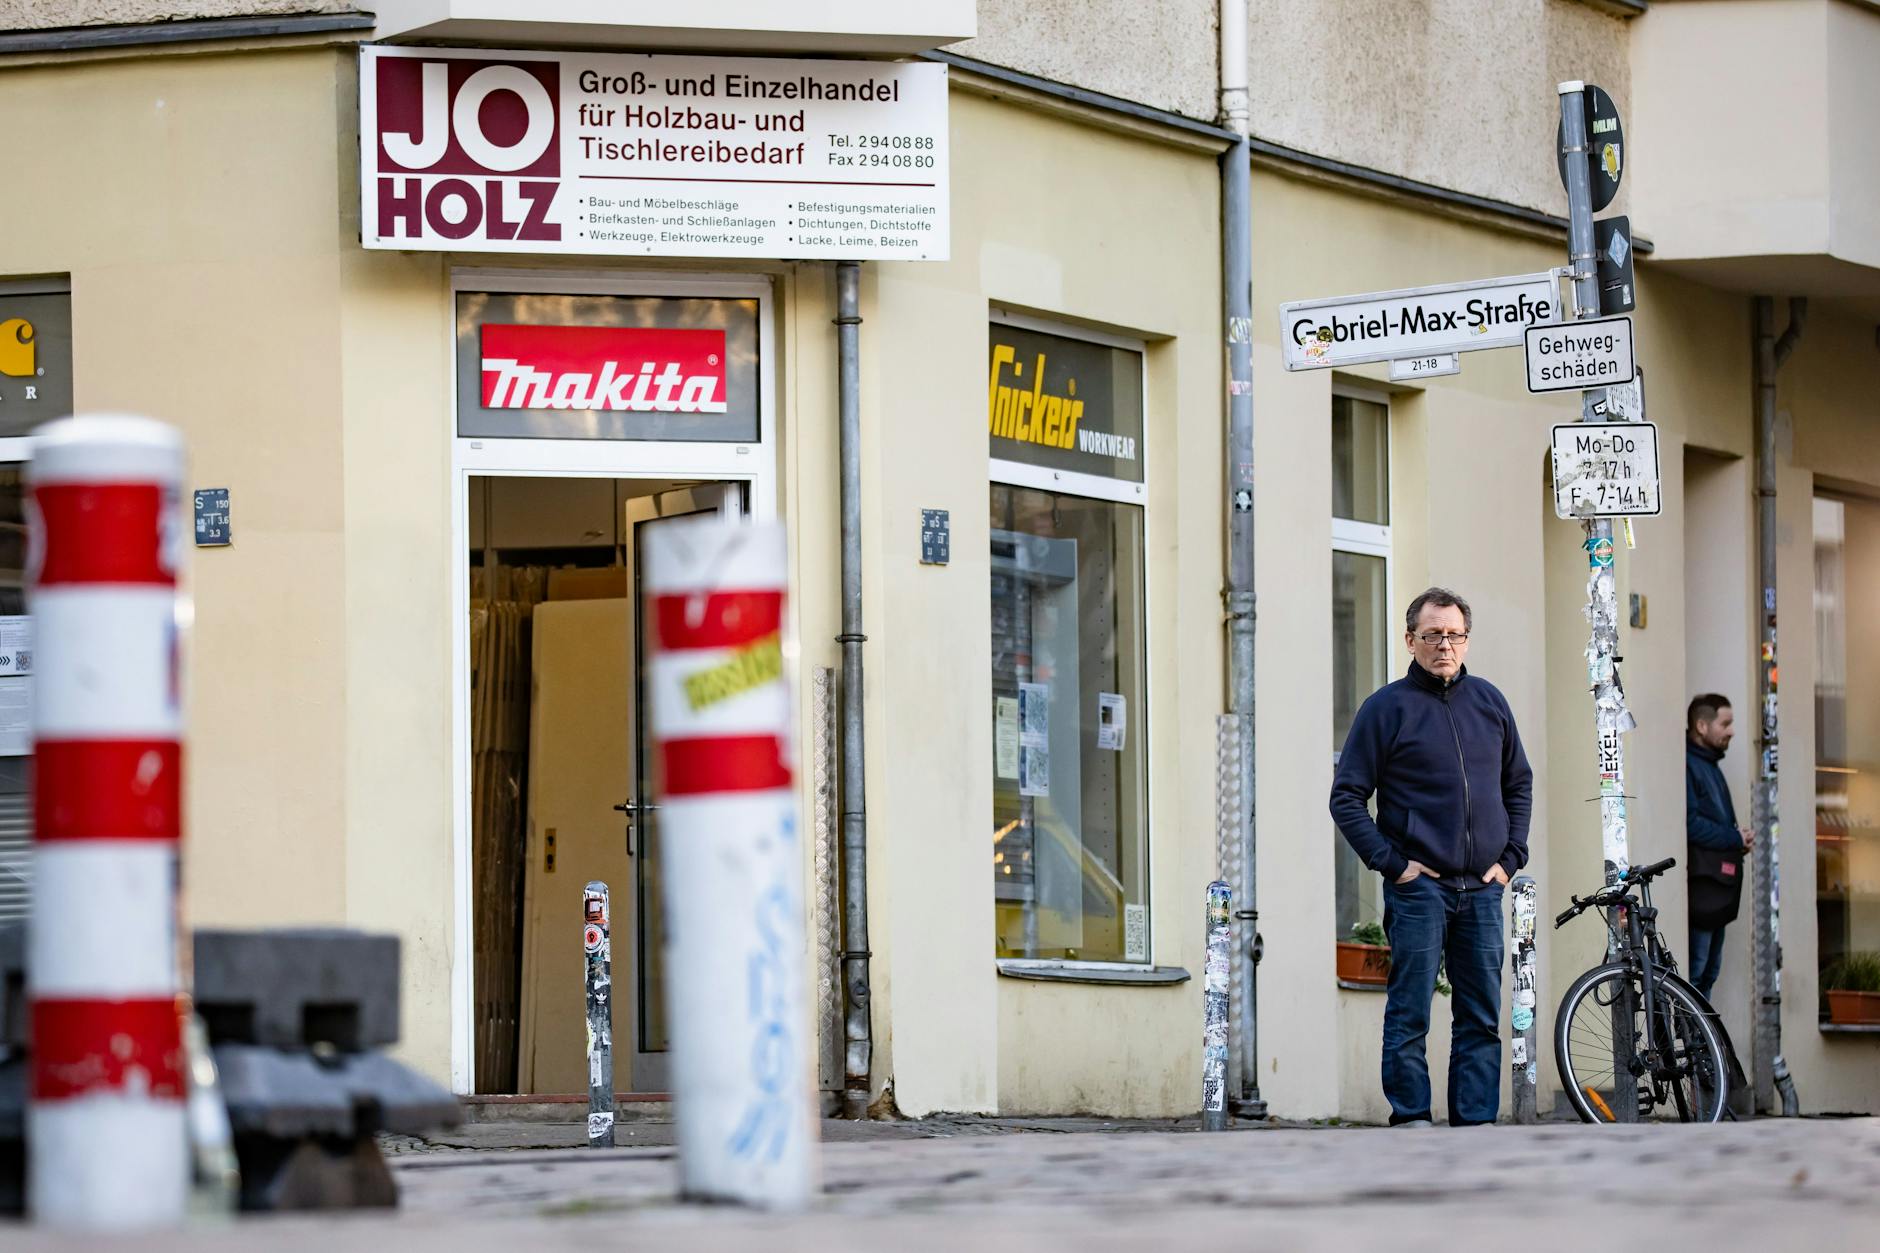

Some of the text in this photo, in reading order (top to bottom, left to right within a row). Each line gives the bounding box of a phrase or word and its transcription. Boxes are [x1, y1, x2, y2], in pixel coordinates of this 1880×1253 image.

[579, 70, 899, 102] Groß- und Einzelhandel
[382, 62, 555, 172] JO
[579, 103, 805, 132] für Holzbau- und
[579, 136, 805, 165] Tischlereibedarf
[828, 134, 854, 148] Tel.
[828, 152, 854, 166] Fax
[377, 177, 562, 242] HOLZ
[588, 196, 740, 212] Bau- und Möbelbeschläge
[797, 201, 936, 216] Befestigungsmaterialien
[588, 213, 777, 230] Briefkasten- und Schließanlagen
[798, 218, 932, 231] Dichtungen, Dichtstoffe
[588, 229, 765, 246] Werkzeuge, Elektrowerkzeuge
[798, 234, 919, 248] Lacke, Leime, Beizen
[1539, 334, 1621, 355] Gehweg-
[1411, 358, 1438, 371] 21-18
[1541, 359, 1618, 381] schäden
[1078, 429, 1136, 461] WORKWEAR
[1576, 435, 1635, 454] Mo-Do
[1623, 460, 1632, 479] h
[1597, 485, 1633, 506] 7-14
[1638, 485, 1647, 505] h
